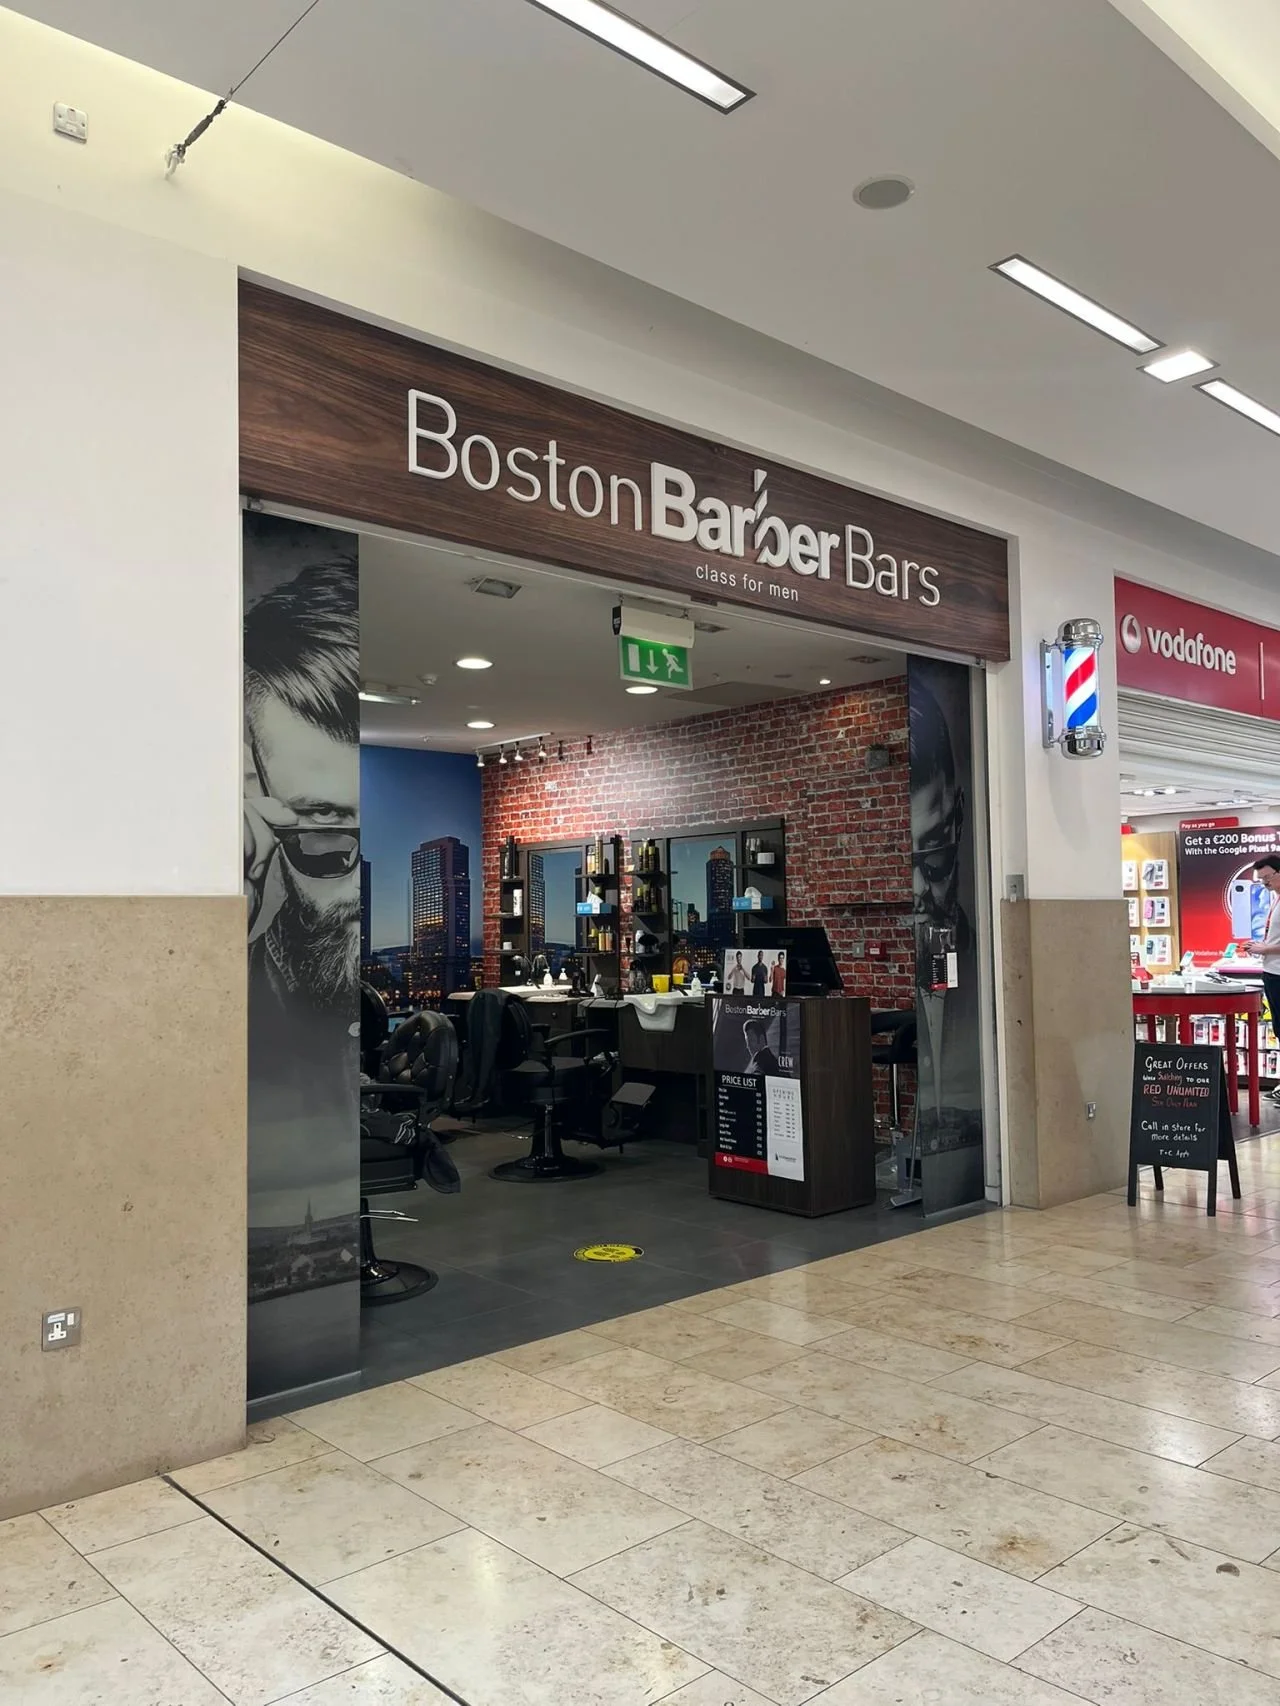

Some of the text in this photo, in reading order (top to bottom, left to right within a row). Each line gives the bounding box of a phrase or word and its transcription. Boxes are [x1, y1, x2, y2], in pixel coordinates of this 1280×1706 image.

[695, 563, 799, 602] class for men
[1145, 626, 1237, 675] vodafone
[1185, 836, 1203, 846] Get
[1213, 834, 1239, 844] €200
[1240, 833, 1276, 843] Bonus
[1185, 847, 1203, 855] With
[1218, 845, 1247, 855] Google
[1248, 844, 1269, 853] Pixel
[777, 1055, 794, 1068] CREW
[1145, 1056, 1208, 1072] GREAT OFFERS
[721, 1074, 757, 1088] PRICE LIST
[1143, 1085, 1161, 1095] RED
[1141, 1120, 1158, 1131] Call
[1171, 1122, 1191, 1132] store
[1173, 1133, 1198, 1142] details
